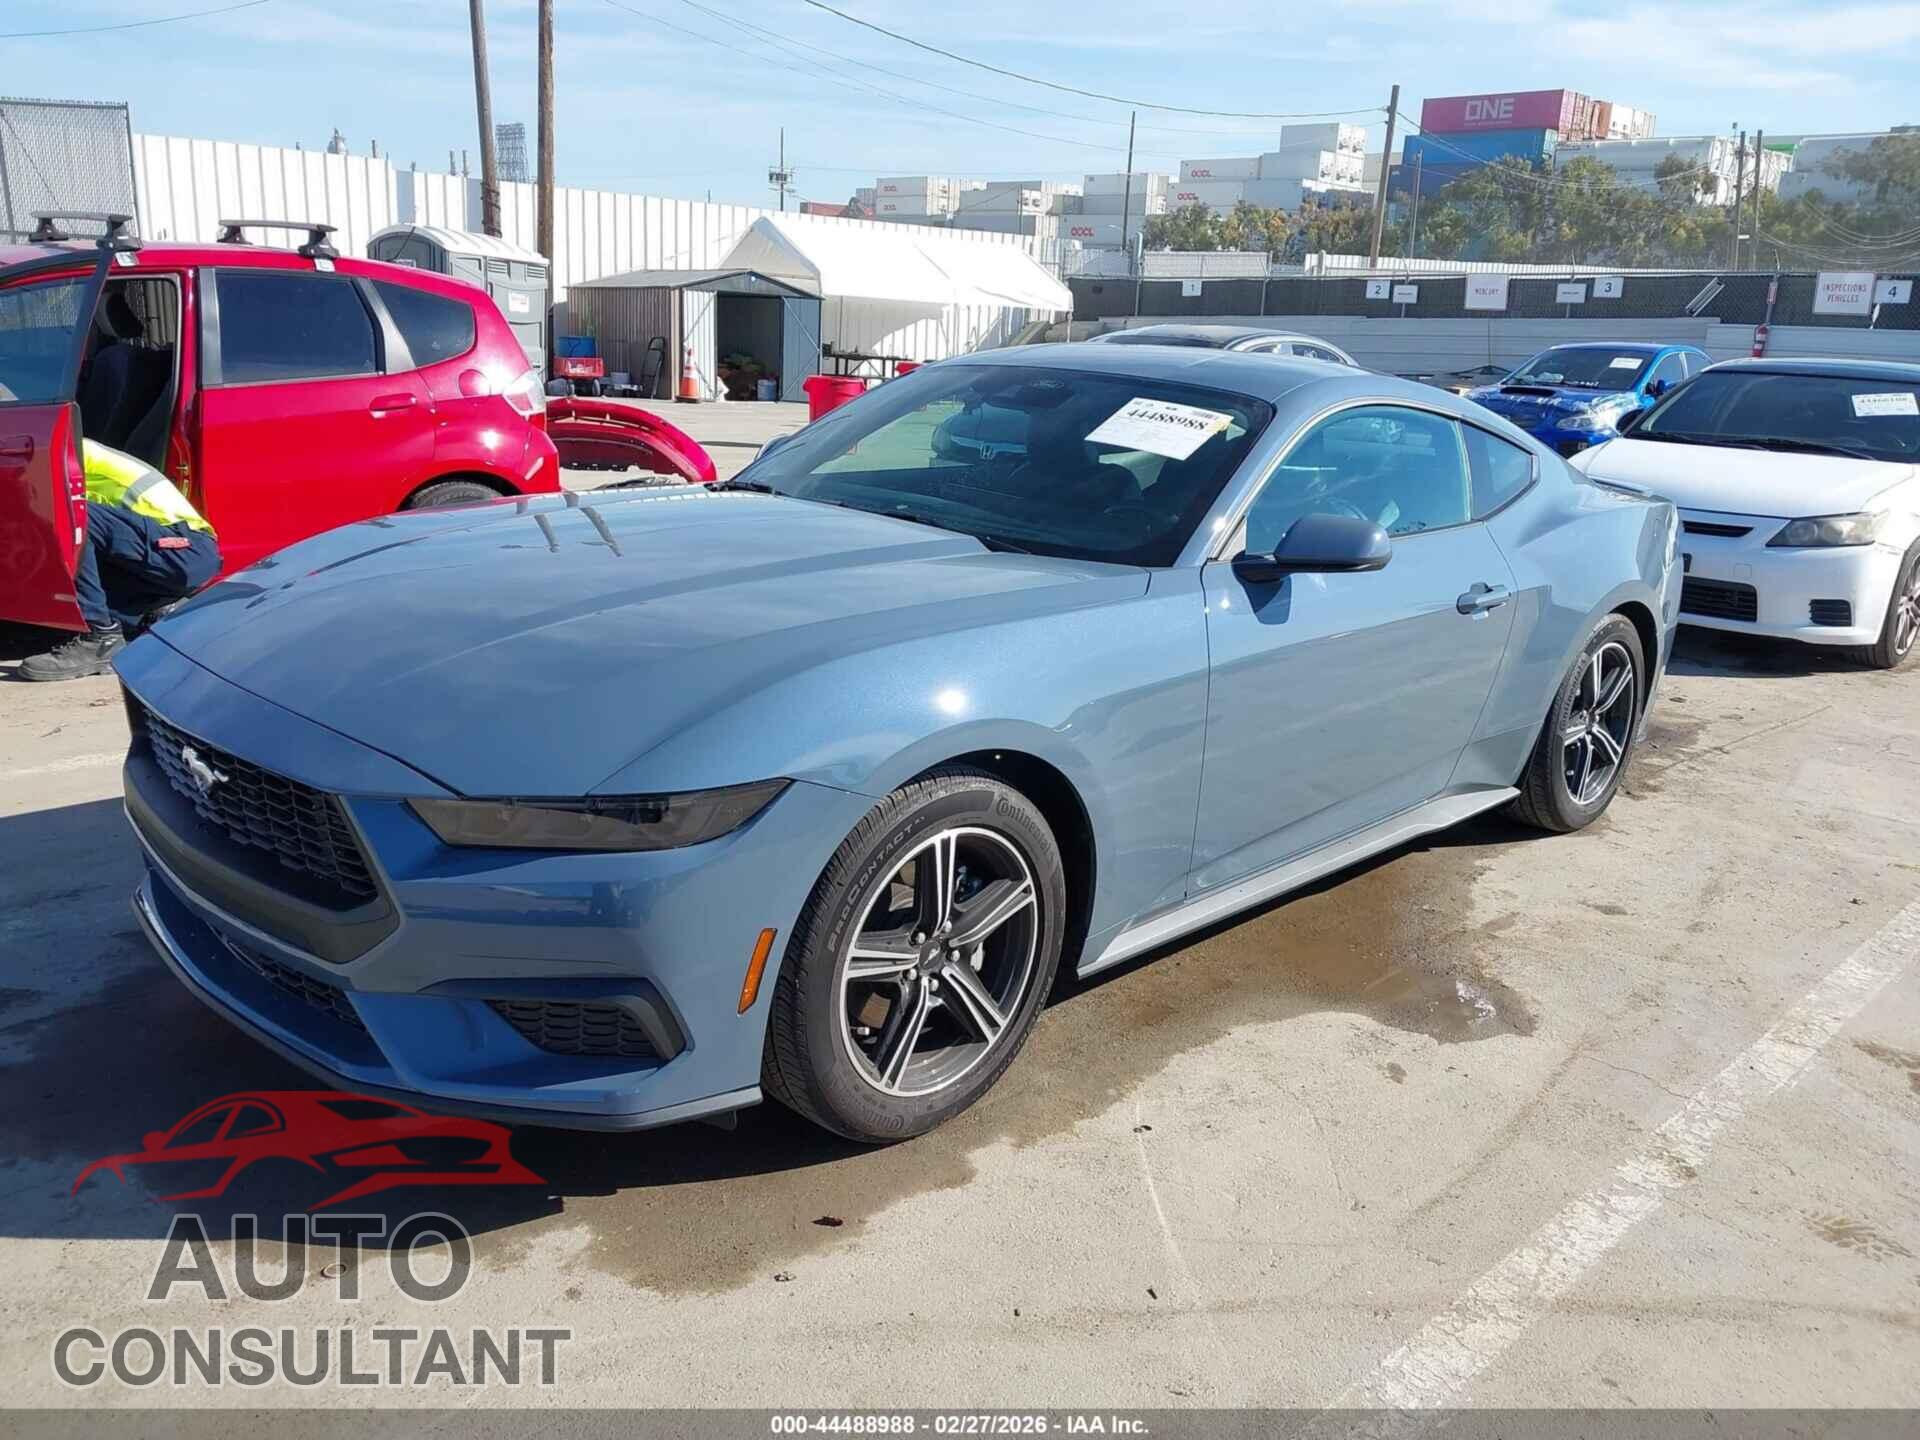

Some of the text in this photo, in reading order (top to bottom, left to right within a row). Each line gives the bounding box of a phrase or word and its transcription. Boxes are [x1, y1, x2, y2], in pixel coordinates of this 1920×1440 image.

[1464, 98, 1514, 121] ONE
[1071, 226, 1095, 237] OOCL
[1375, 284, 1383, 295] 2
[1604, 281, 1613, 293] 3
[1823, 283, 1867, 293] INSPECTIONS
[1887, 286, 1898, 299] 4
[1127, 408, 1209, 431] 44488988
[827, 823, 913, 952] PROCONTACT
